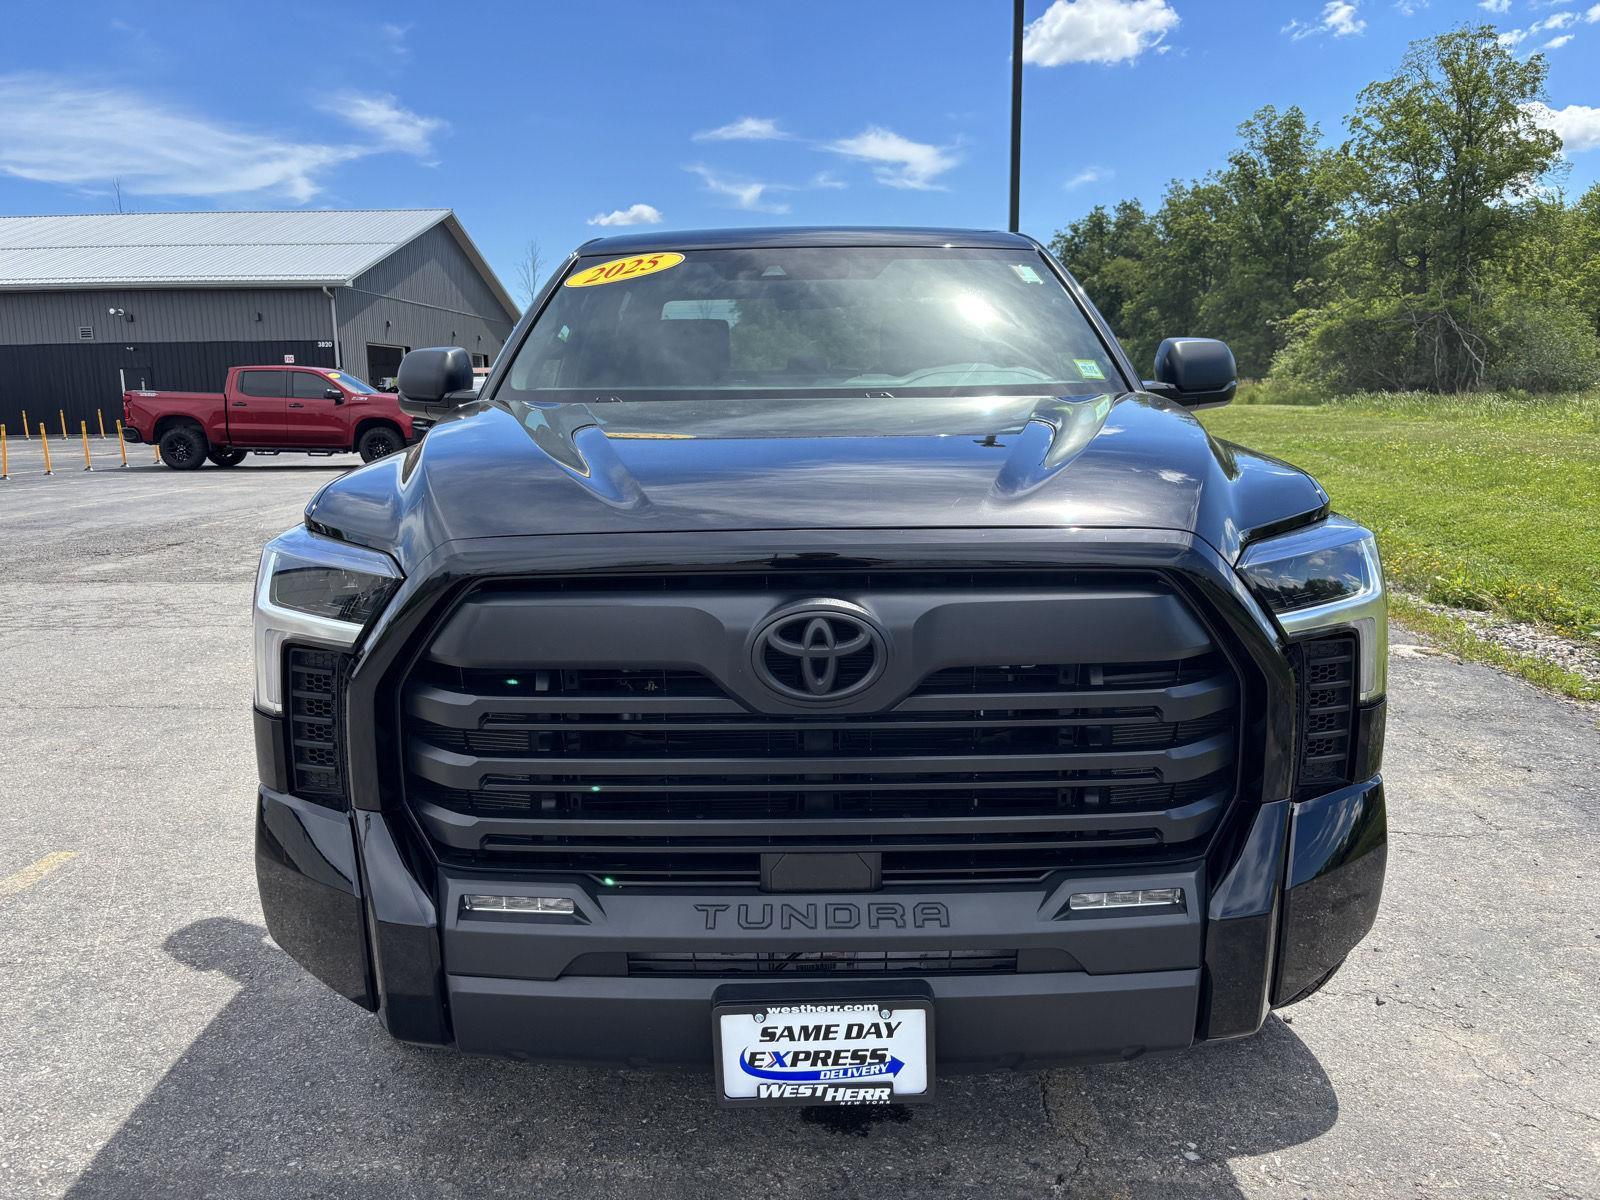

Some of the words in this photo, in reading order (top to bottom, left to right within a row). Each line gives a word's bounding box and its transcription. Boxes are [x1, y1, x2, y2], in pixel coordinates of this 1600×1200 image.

[583, 255, 664, 284] 2025
[692, 902, 950, 930] TUNDRA
[766, 1004, 879, 1015] westherr.com
[759, 1024, 840, 1043] SAME
[844, 1021, 902, 1041] DAY
[747, 1047, 889, 1069] EXPRESS
[819, 1062, 890, 1081] DELIVERY
